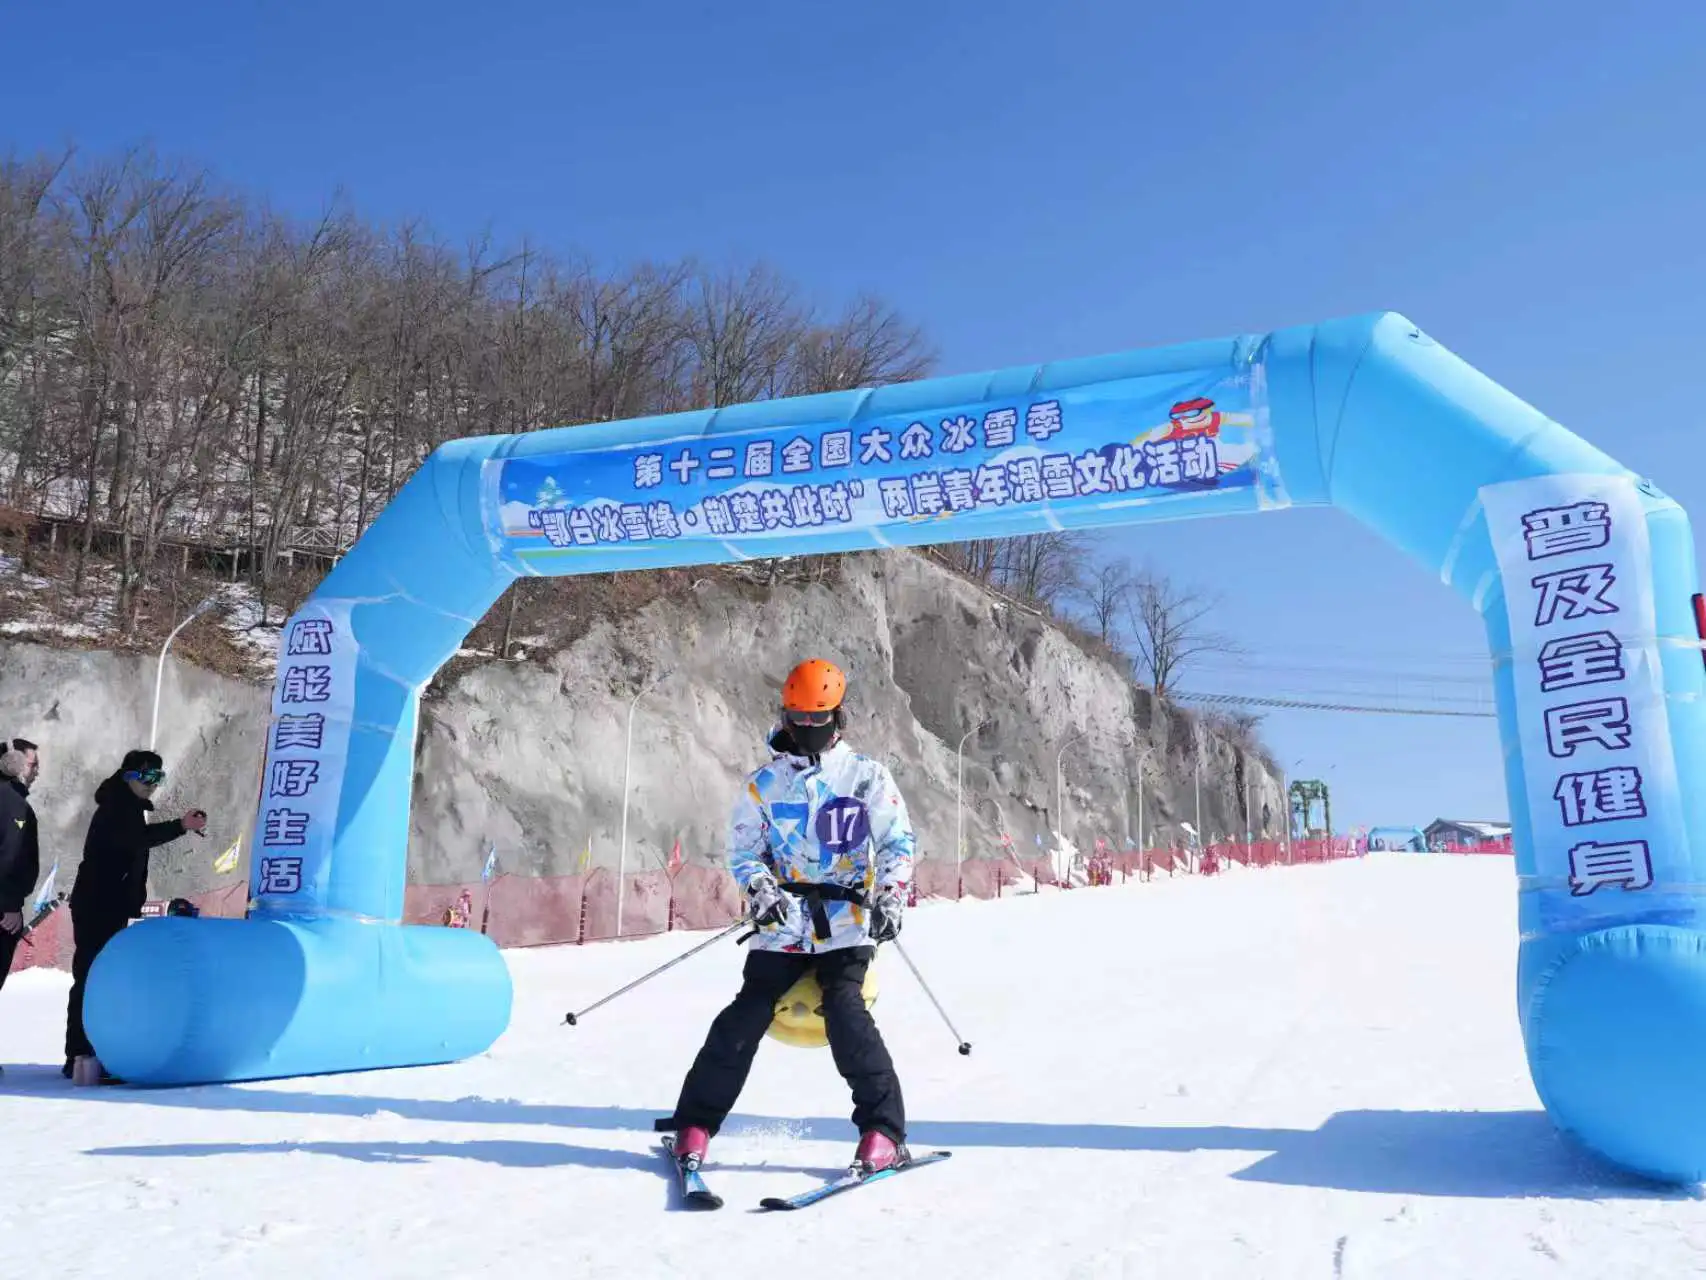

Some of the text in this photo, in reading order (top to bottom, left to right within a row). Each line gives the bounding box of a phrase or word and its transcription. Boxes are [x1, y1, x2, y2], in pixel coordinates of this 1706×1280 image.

[633, 399, 1063, 488] 第十二届全国大众冰雪季
[258, 619, 333, 895] 赋能美好生活
[1521, 501, 1654, 896] 普及全民健身
[826, 806, 861, 846] 17
